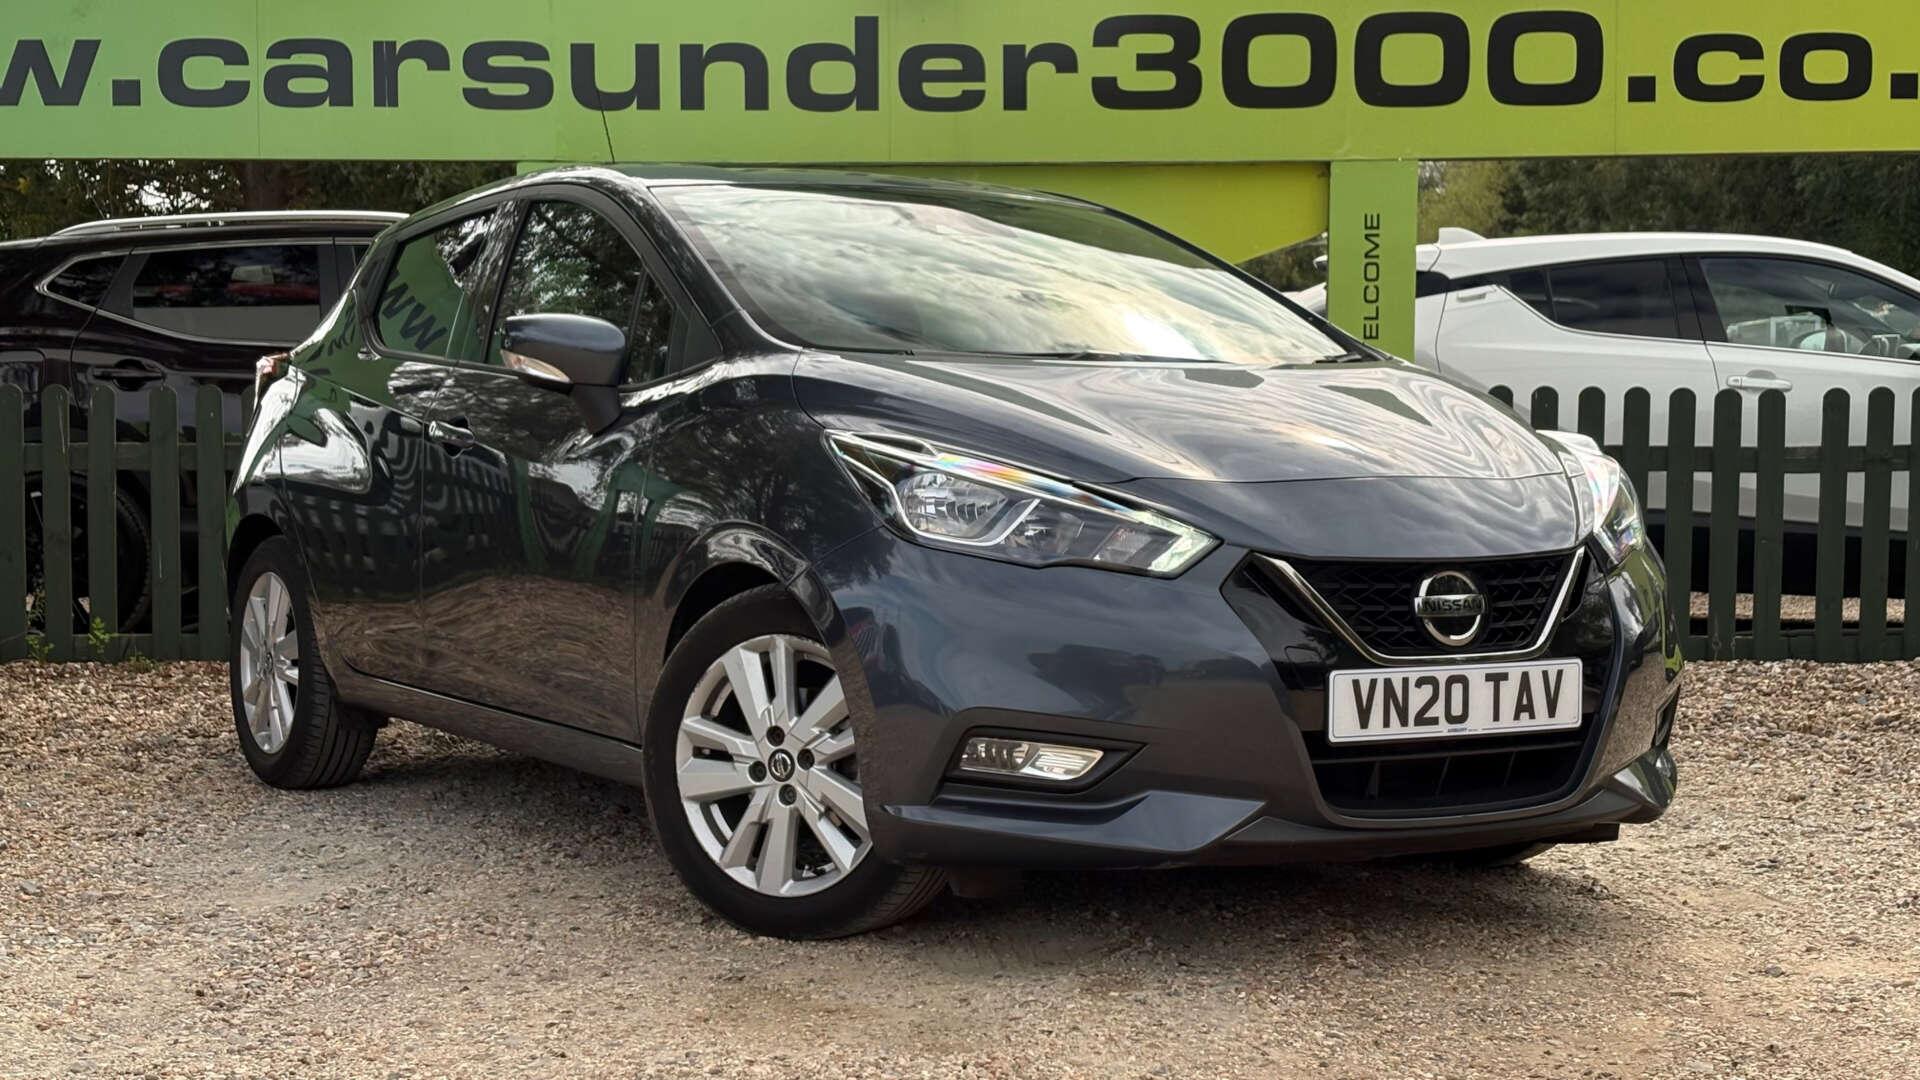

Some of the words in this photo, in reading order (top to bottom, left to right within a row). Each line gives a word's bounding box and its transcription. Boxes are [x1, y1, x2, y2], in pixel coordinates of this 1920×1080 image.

[1363, 213, 1381, 340] ELCOME
[1422, 597, 1482, 612] NISSAN
[1351, 674, 1470, 730] VN20
[1484, 668, 1564, 723] TAV
